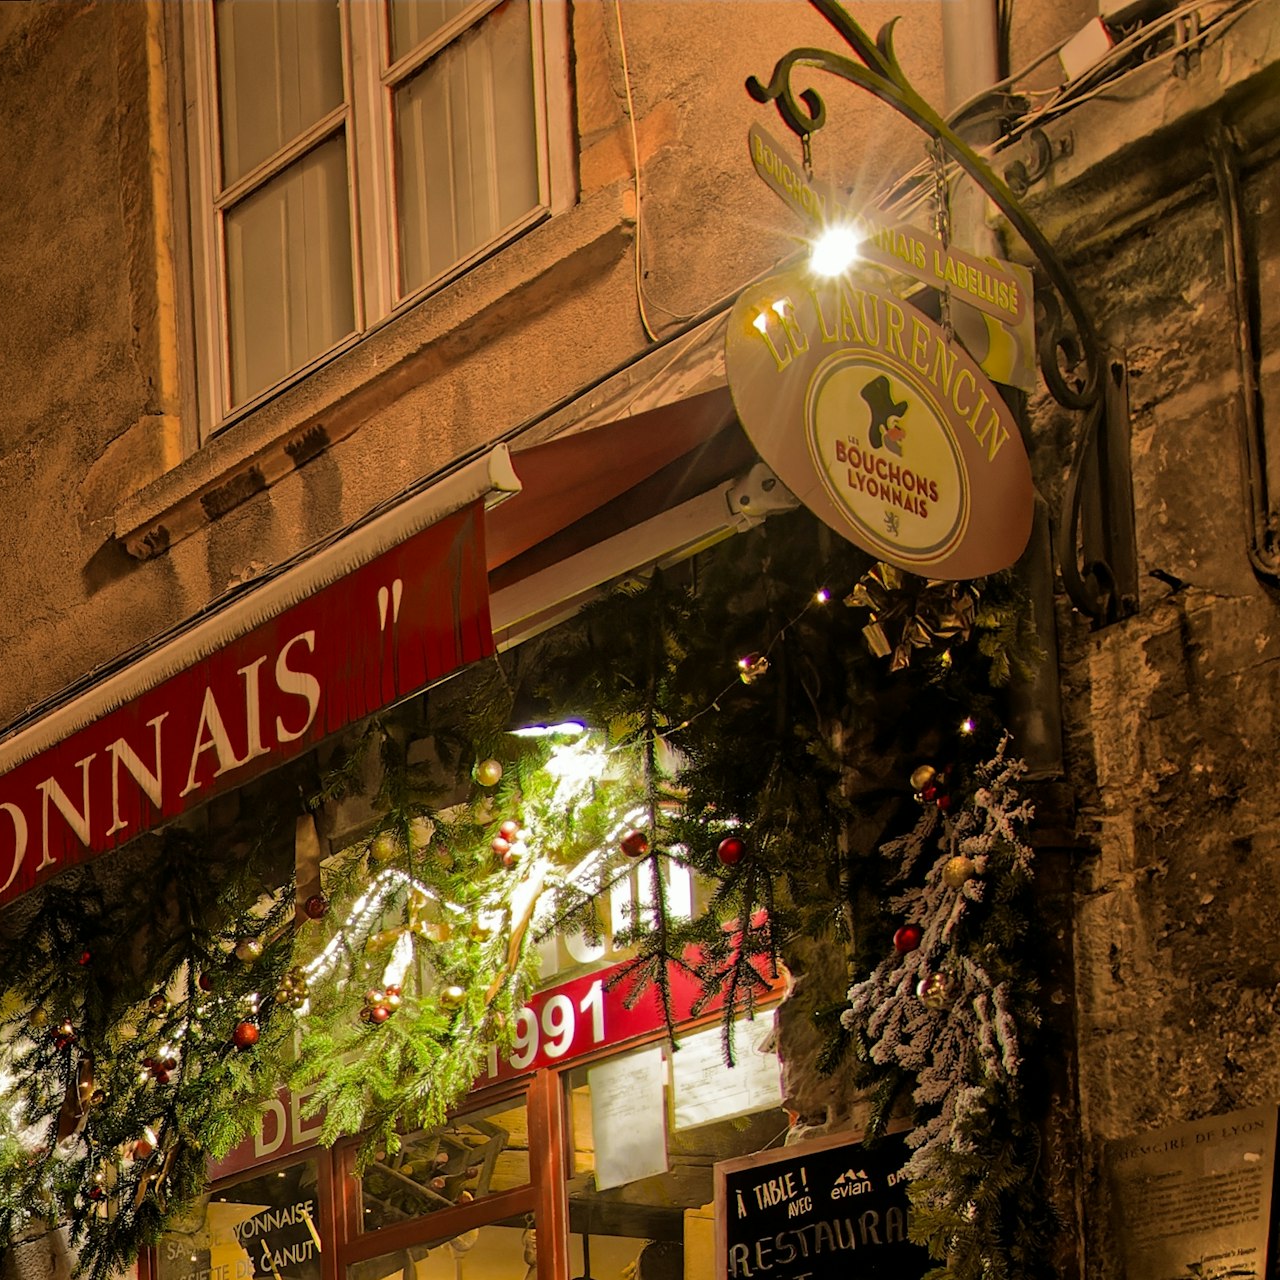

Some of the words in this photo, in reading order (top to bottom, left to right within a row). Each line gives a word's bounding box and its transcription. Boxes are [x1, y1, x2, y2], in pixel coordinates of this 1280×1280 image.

[754, 134, 825, 228] BOUCHON
[934, 249, 1019, 315] LABELLISÉ
[753, 296, 810, 373] LE
[809, 278, 1011, 463] LAURENCIN
[835, 439, 939, 503] BOUCHONS
[847, 468, 928, 519] LYONNAIS
[1222, 1120, 1265, 1138] LYON
[753, 1172, 799, 1211] TABLE
[830, 1180, 873, 1200] evian
[788, 1195, 813, 1220] AVEC
[230, 1199, 314, 1242] YONNAISE
[728, 1206, 909, 1279] RESTAURA
[236, 1256, 255, 1280] DE
[260, 1239, 314, 1273] CANUT
